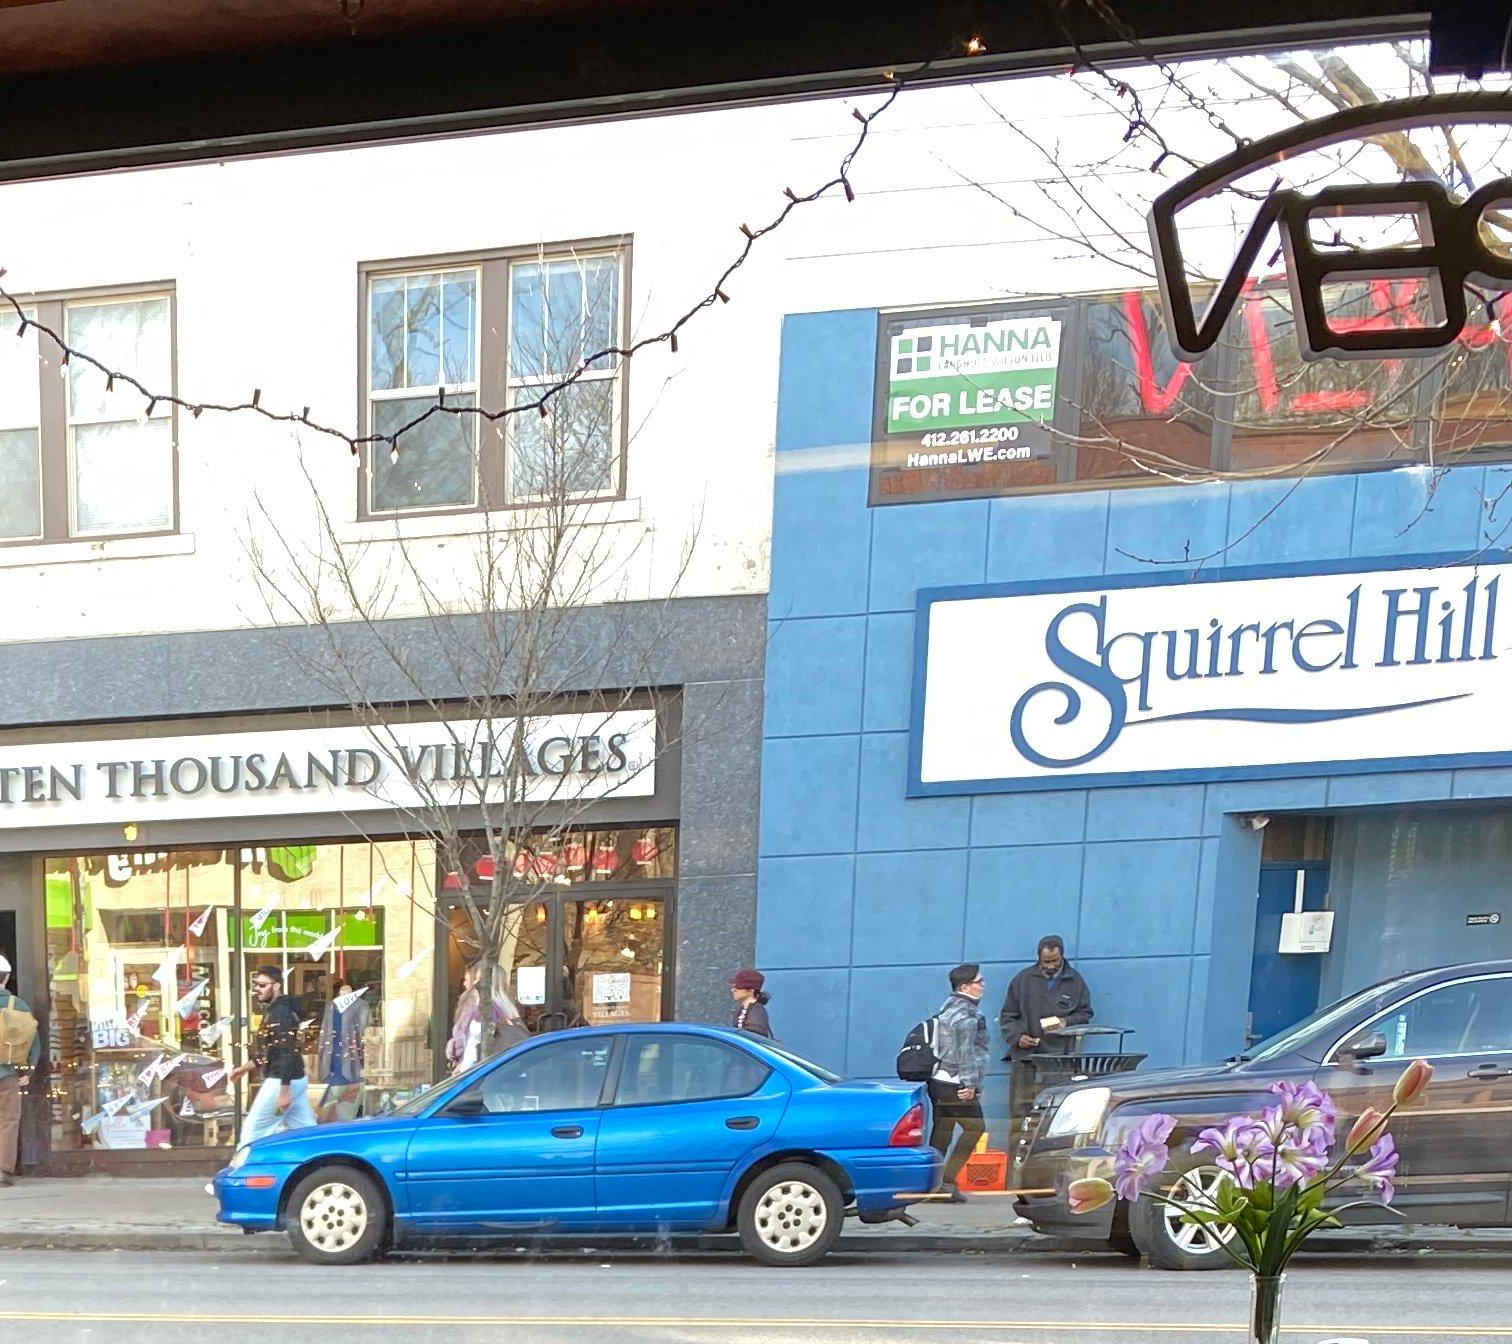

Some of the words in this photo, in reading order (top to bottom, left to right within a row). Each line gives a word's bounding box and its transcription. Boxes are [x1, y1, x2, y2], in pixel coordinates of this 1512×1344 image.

[940, 326, 1051, 357] HANNA
[893, 392, 951, 420] FOR
[959, 384, 1052, 415] LEASE
[907, 446, 1031, 468] HannaLWE.com
[1009, 584, 1363, 768] Squirrel
[1375, 574, 1501, 667] Hill
[96, 747, 381, 798] THOUSAND
[395, 732, 629, 783] VILLAGES
